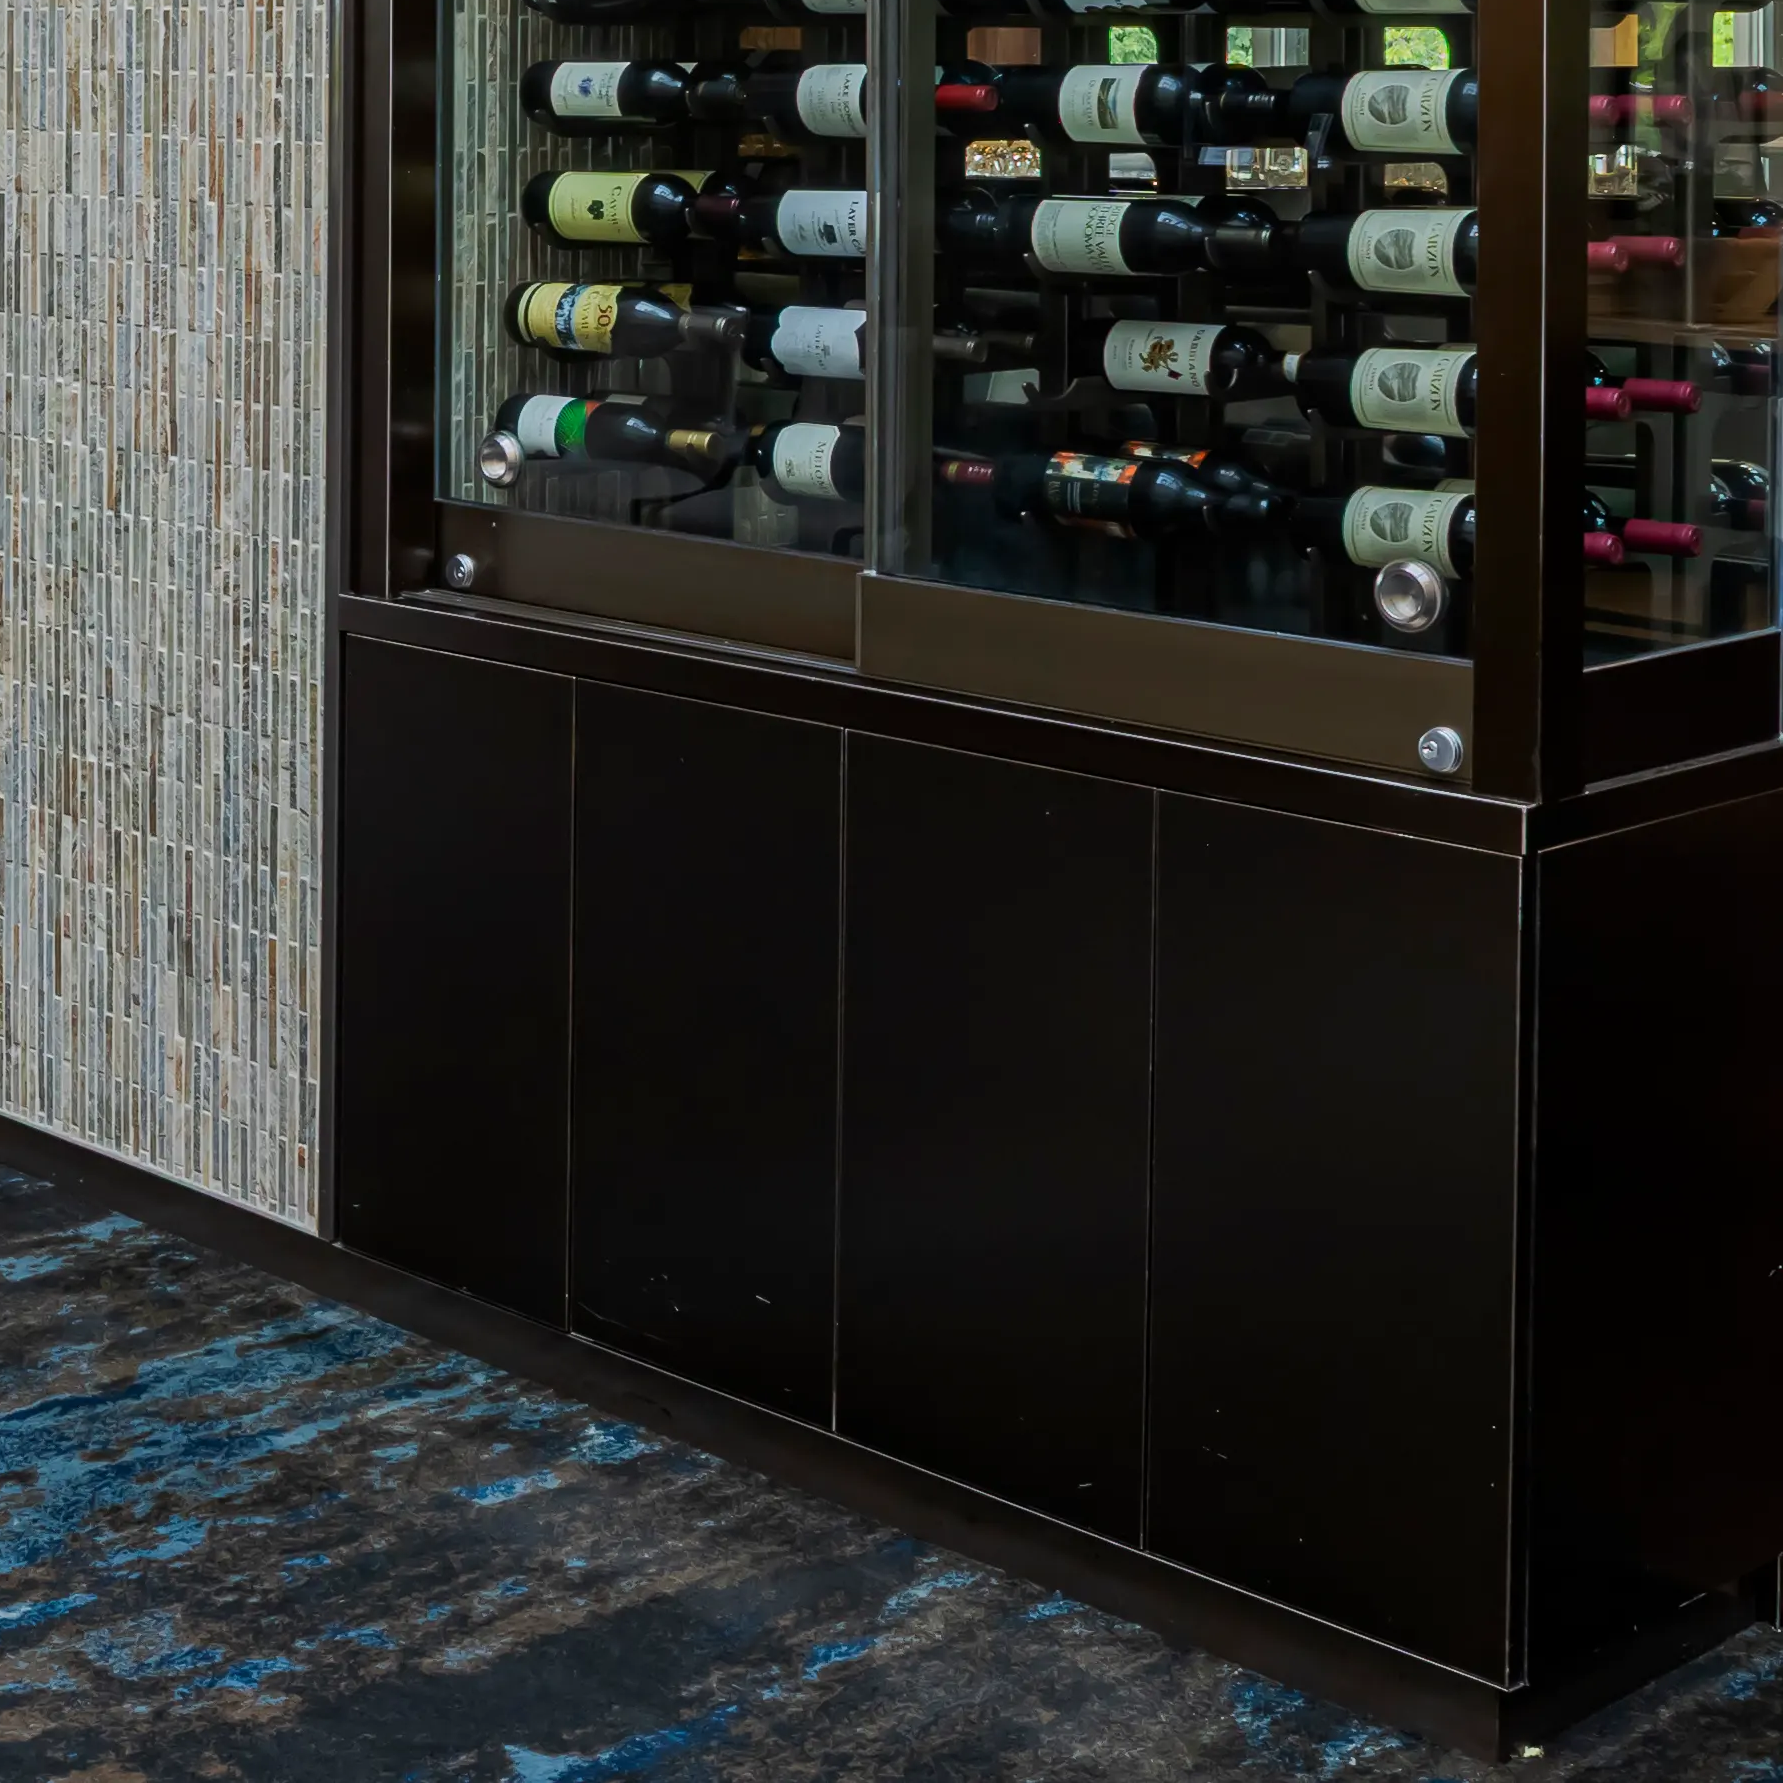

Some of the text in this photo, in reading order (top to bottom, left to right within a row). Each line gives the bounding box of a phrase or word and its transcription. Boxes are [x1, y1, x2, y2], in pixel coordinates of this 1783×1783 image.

[842, 72, 853, 97] LAKE
[848, 201, 860, 237] LAYER
[1094, 205, 1111, 237] THREE
